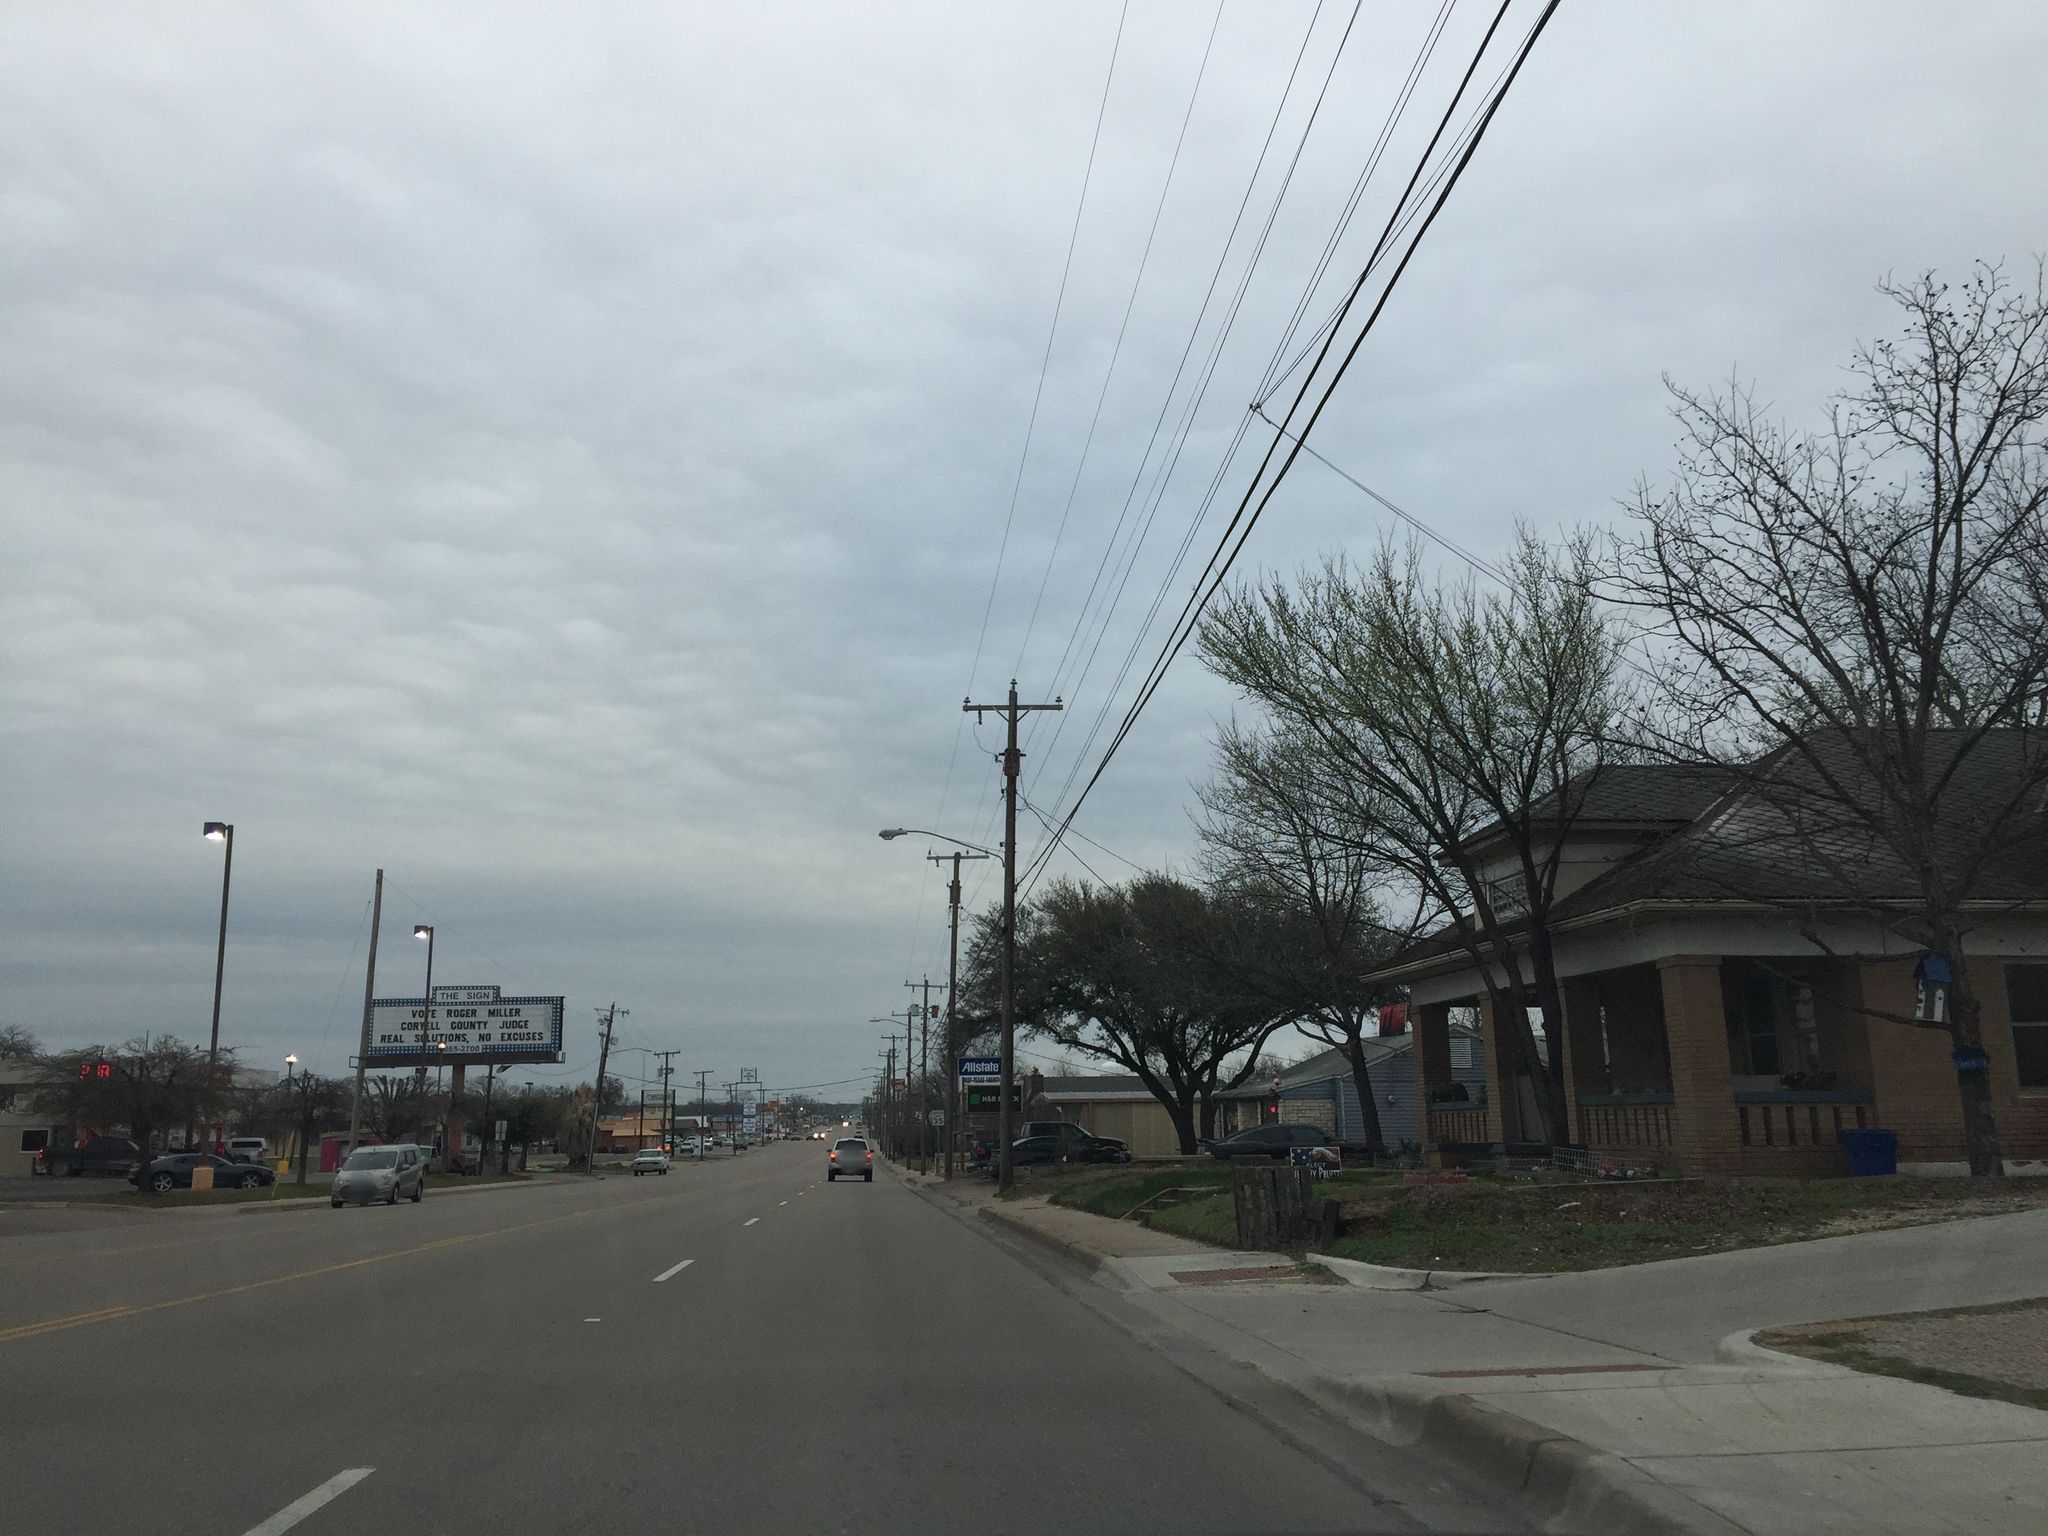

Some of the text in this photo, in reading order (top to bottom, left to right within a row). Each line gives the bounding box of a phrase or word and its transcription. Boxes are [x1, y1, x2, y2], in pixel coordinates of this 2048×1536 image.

[440, 991, 490, 1000] THE SIGN
[412, 1008, 521, 1019] VOTE ROGER MILLER
[400, 1020, 529, 1031] CORYELL COUNTY JUDGE
[380, 1032, 543, 1044] REAL SOLUTIONS, NO EXCUSES
[961, 1062, 999, 1073] Allstate
